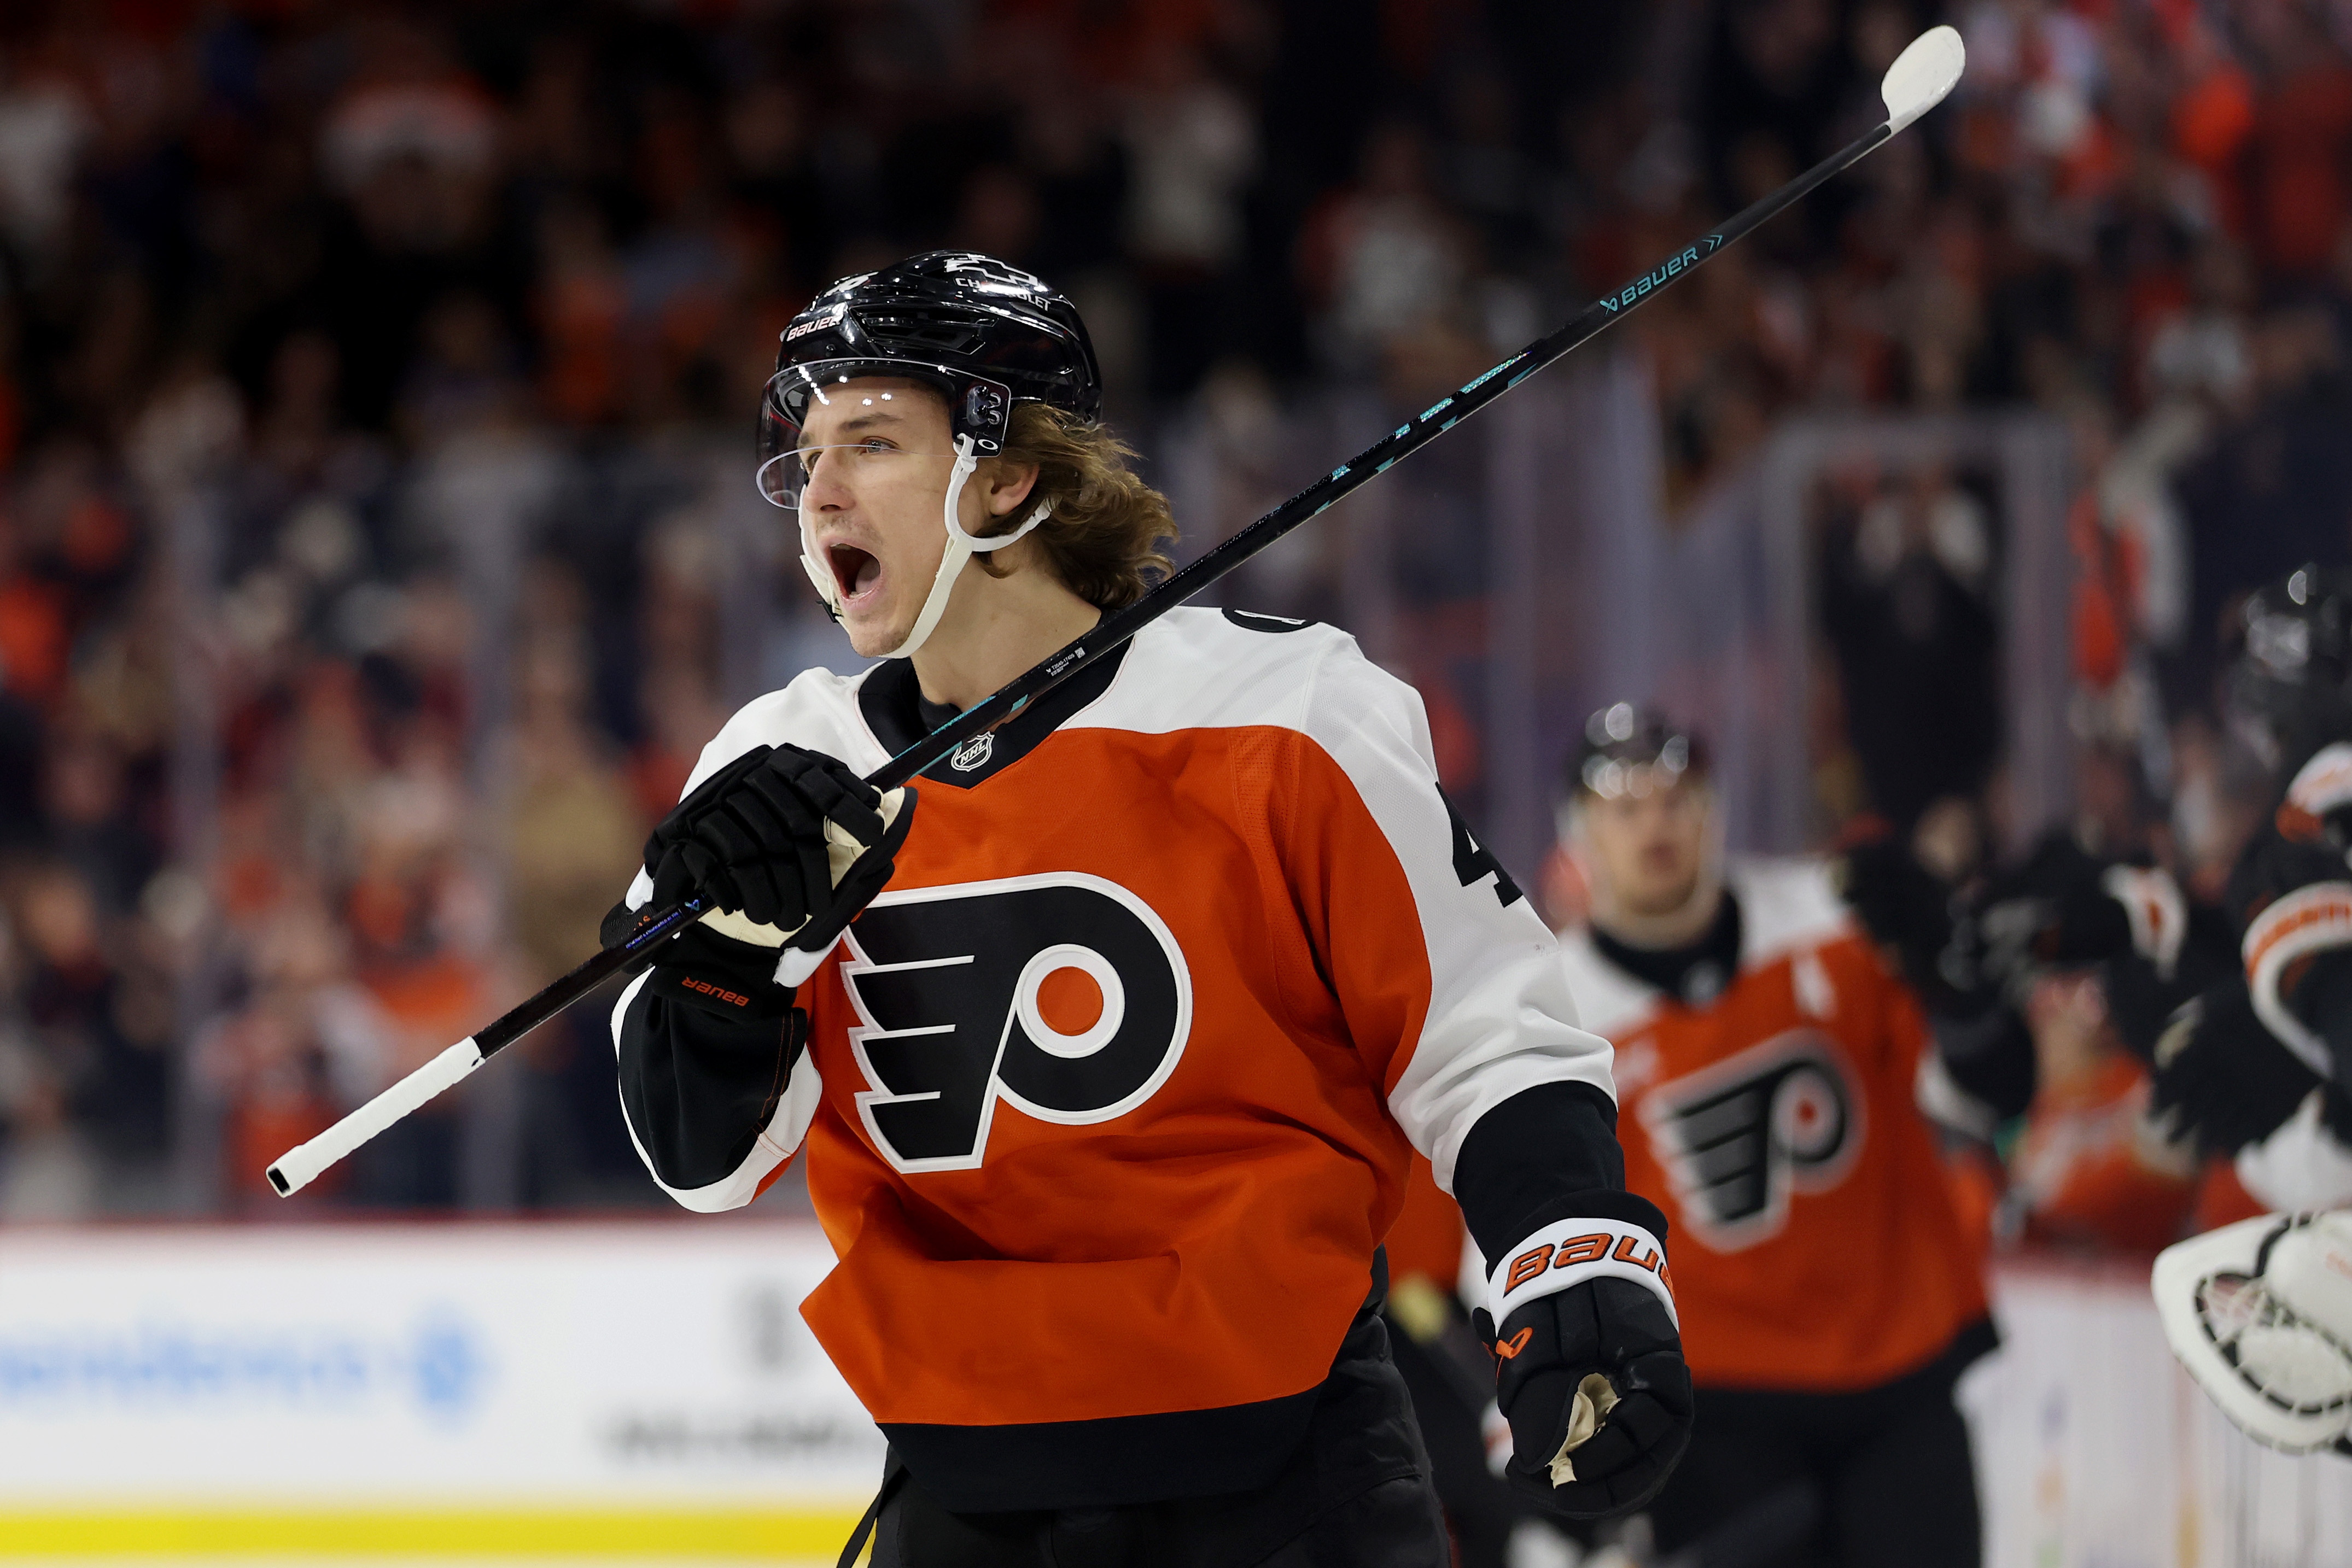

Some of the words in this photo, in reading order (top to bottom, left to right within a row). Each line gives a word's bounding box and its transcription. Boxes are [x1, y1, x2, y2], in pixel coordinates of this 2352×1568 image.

[1621, 247, 1699, 306] BAUER
[954, 277, 1051, 312] CHOLET
[960, 742, 985, 765] NHL
[682, 976, 749, 1007] BAUER
